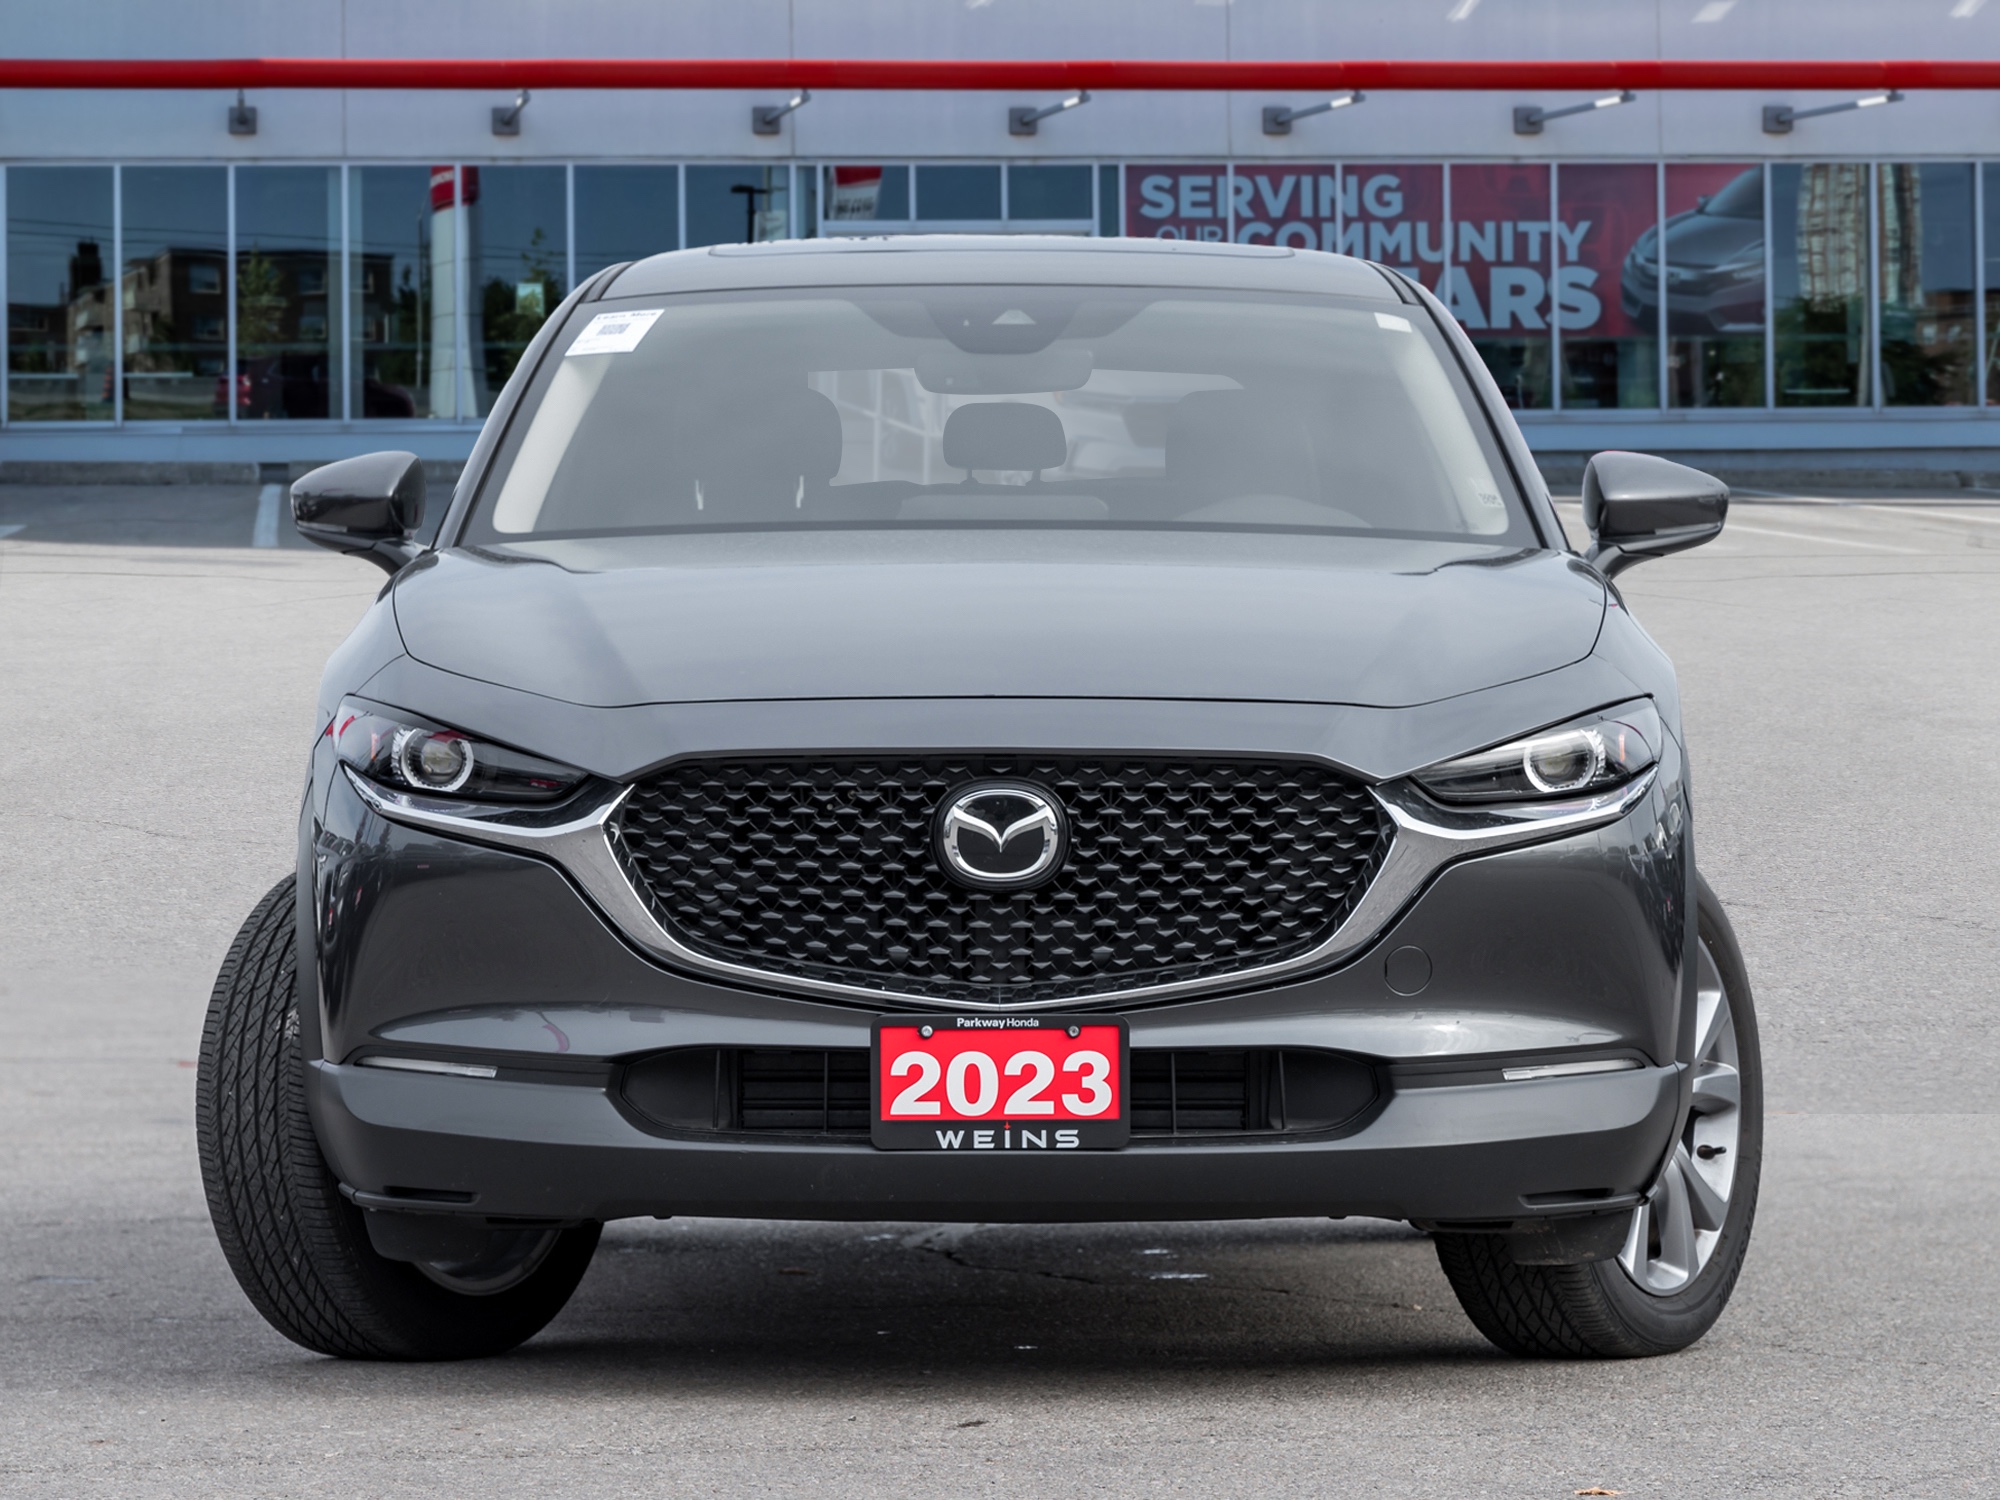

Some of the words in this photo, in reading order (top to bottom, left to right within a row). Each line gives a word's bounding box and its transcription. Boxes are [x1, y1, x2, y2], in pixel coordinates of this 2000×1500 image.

[1139, 174, 1404, 219] SERVING
[1236, 220, 1593, 263] COMMUNITY
[1391, 266, 1602, 330] ARS
[956, 1017, 1005, 1029] Parkway
[1006, 1017, 1040, 1028] Honda
[889, 1050, 1113, 1117] 2023
